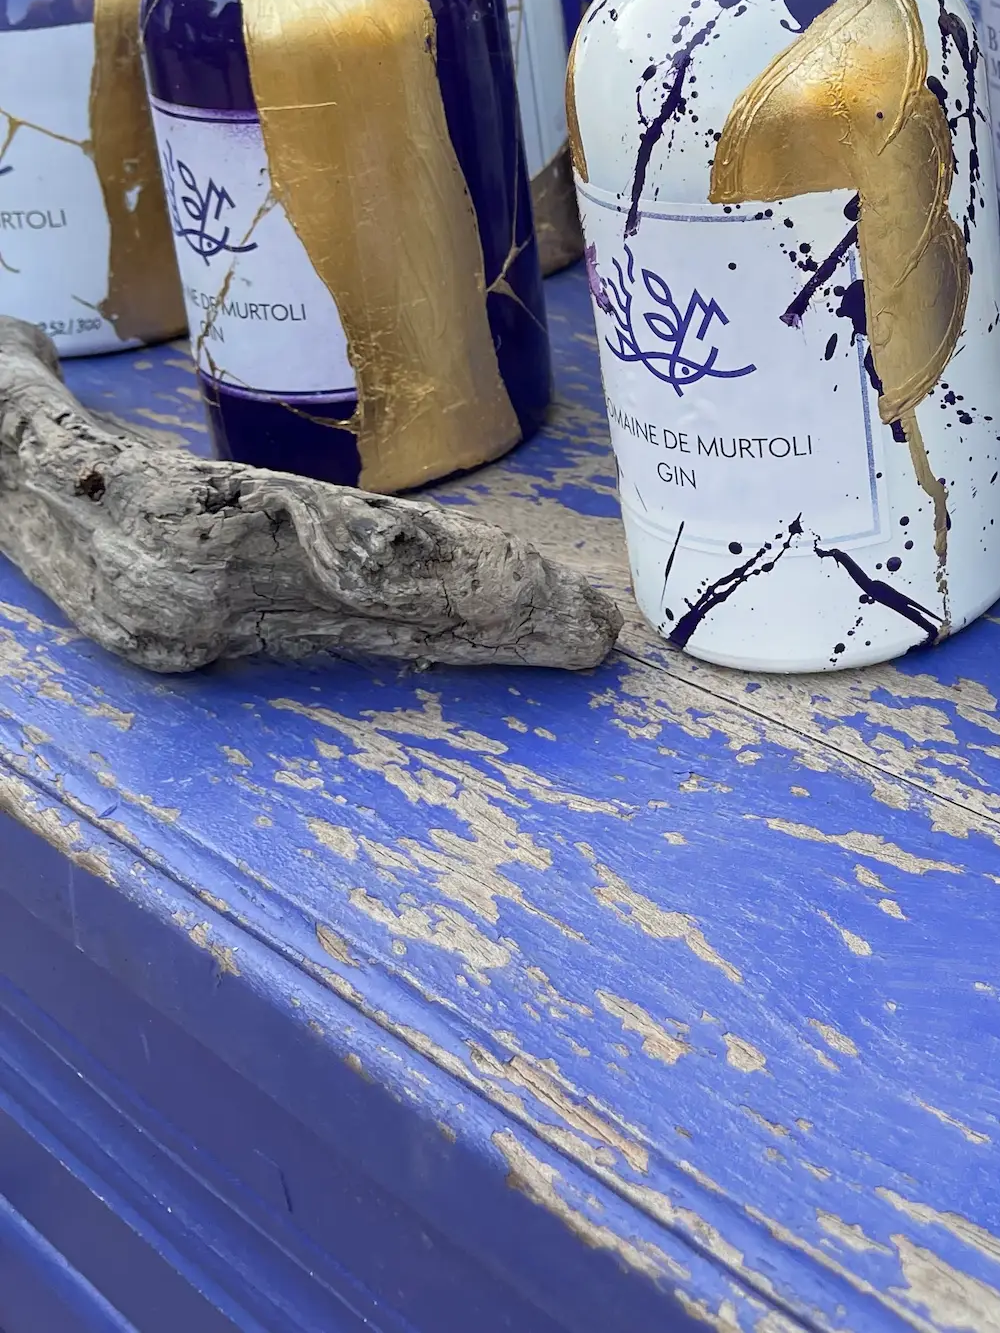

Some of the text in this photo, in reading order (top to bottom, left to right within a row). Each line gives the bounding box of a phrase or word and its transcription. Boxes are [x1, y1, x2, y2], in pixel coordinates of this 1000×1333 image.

[0, 208, 67, 230] RTOLI
[221, 301, 306, 321] MURTOLI
[606, 397, 812, 459] OMAINE DE MURTOLI
[657, 462, 697, 490] GIN
